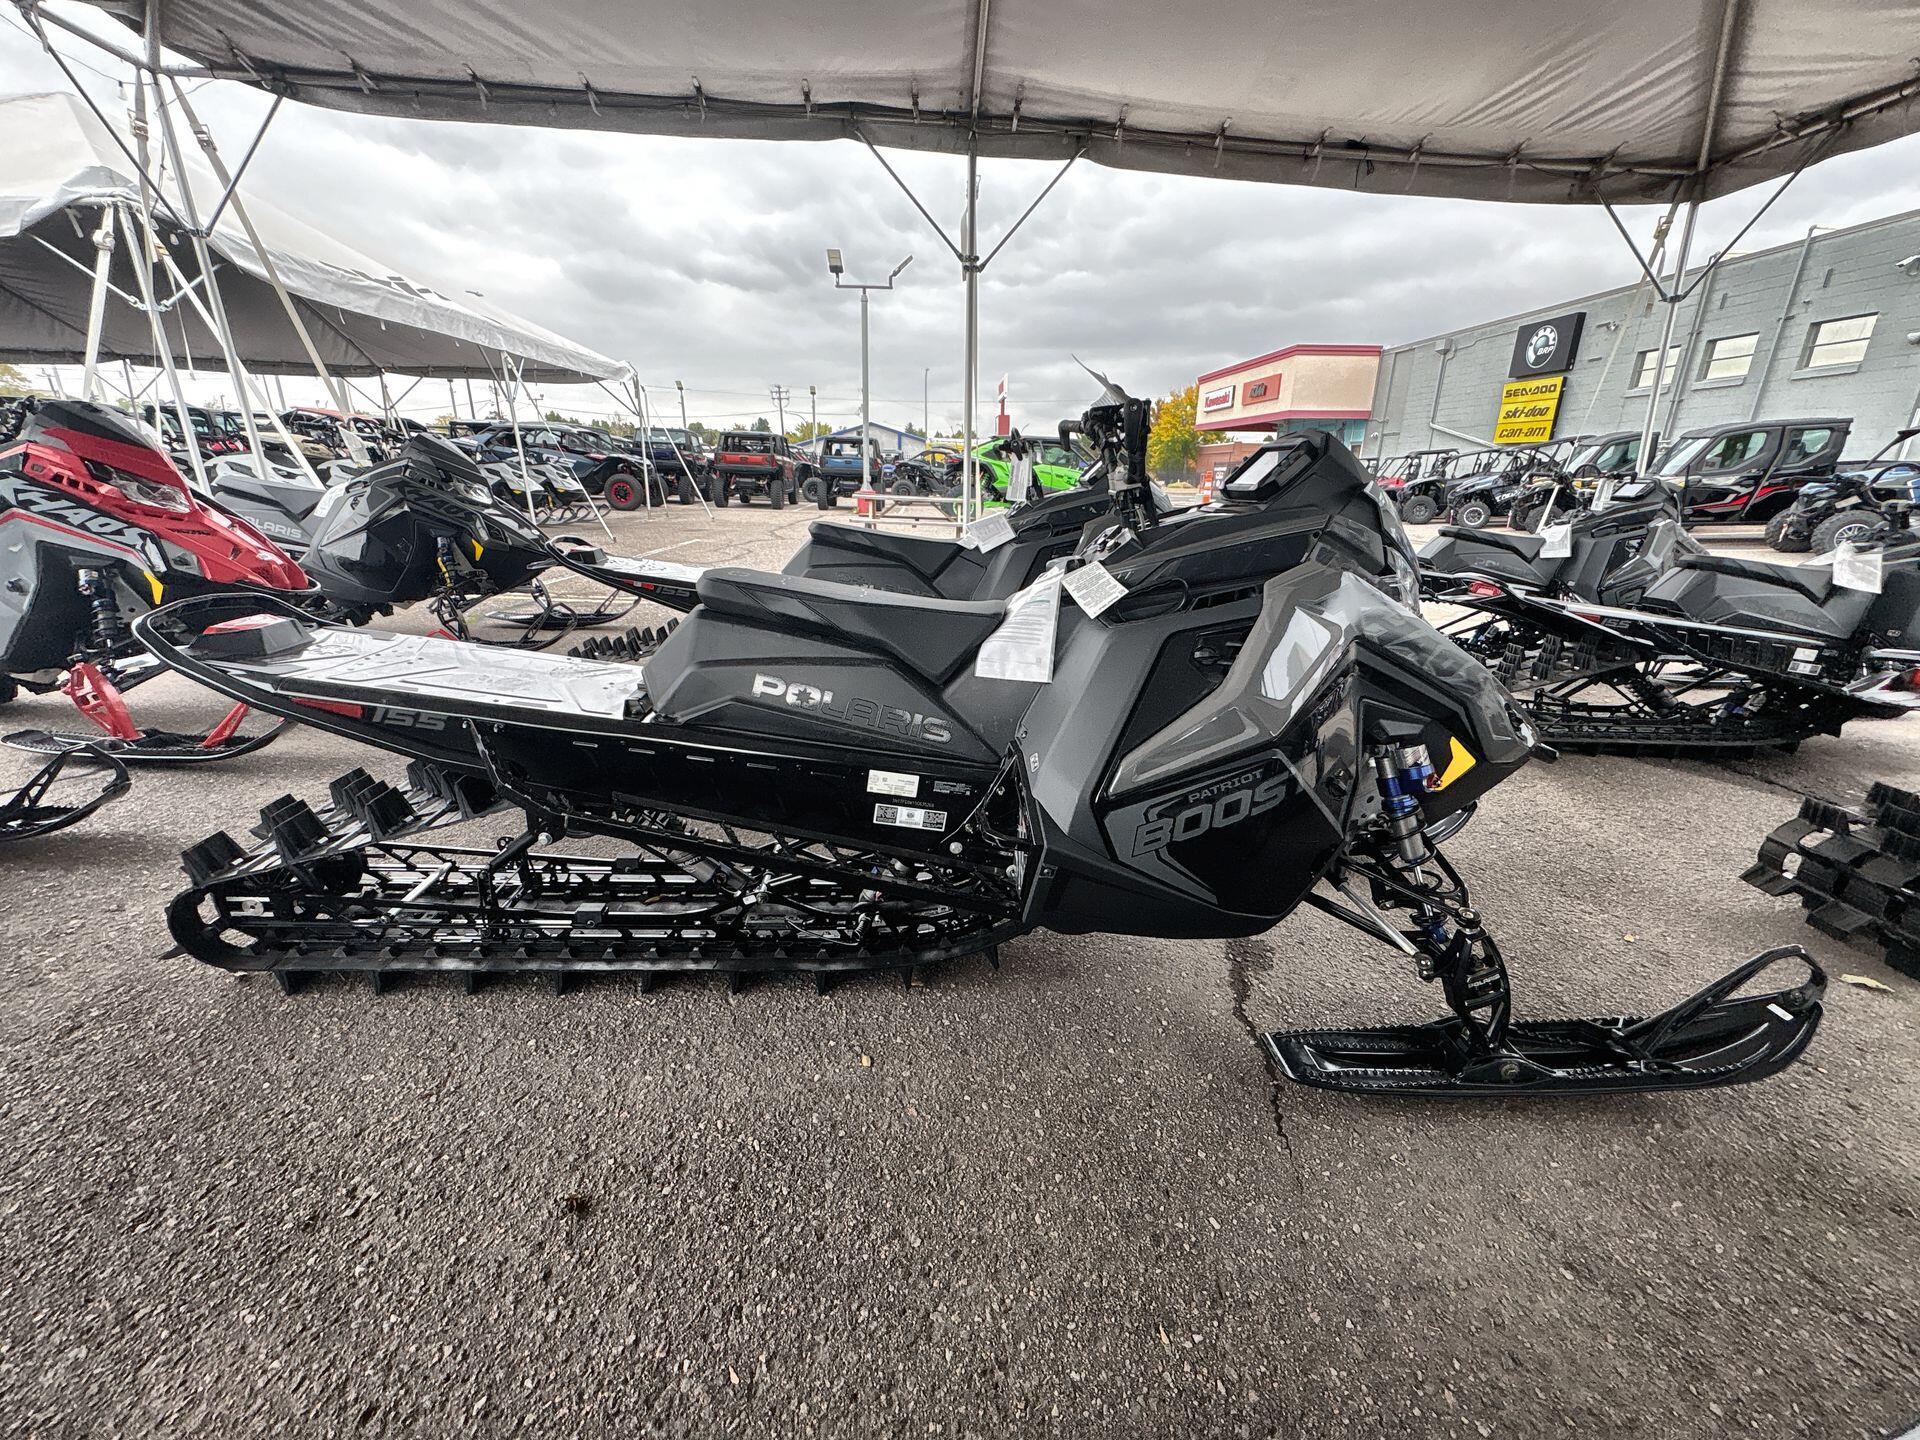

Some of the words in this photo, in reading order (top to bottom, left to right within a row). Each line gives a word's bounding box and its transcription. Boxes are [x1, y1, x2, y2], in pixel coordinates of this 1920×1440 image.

[1536, 345, 1554, 356] BRP
[1205, 390, 1231, 408] Kawasaki
[1503, 406, 1550, 419] ski-doo
[1498, 426, 1547, 438] can-am
[372, 702, 448, 731] 155
[751, 672, 952, 744] POLARIS
[1188, 769, 1264, 803] PATRIOT
